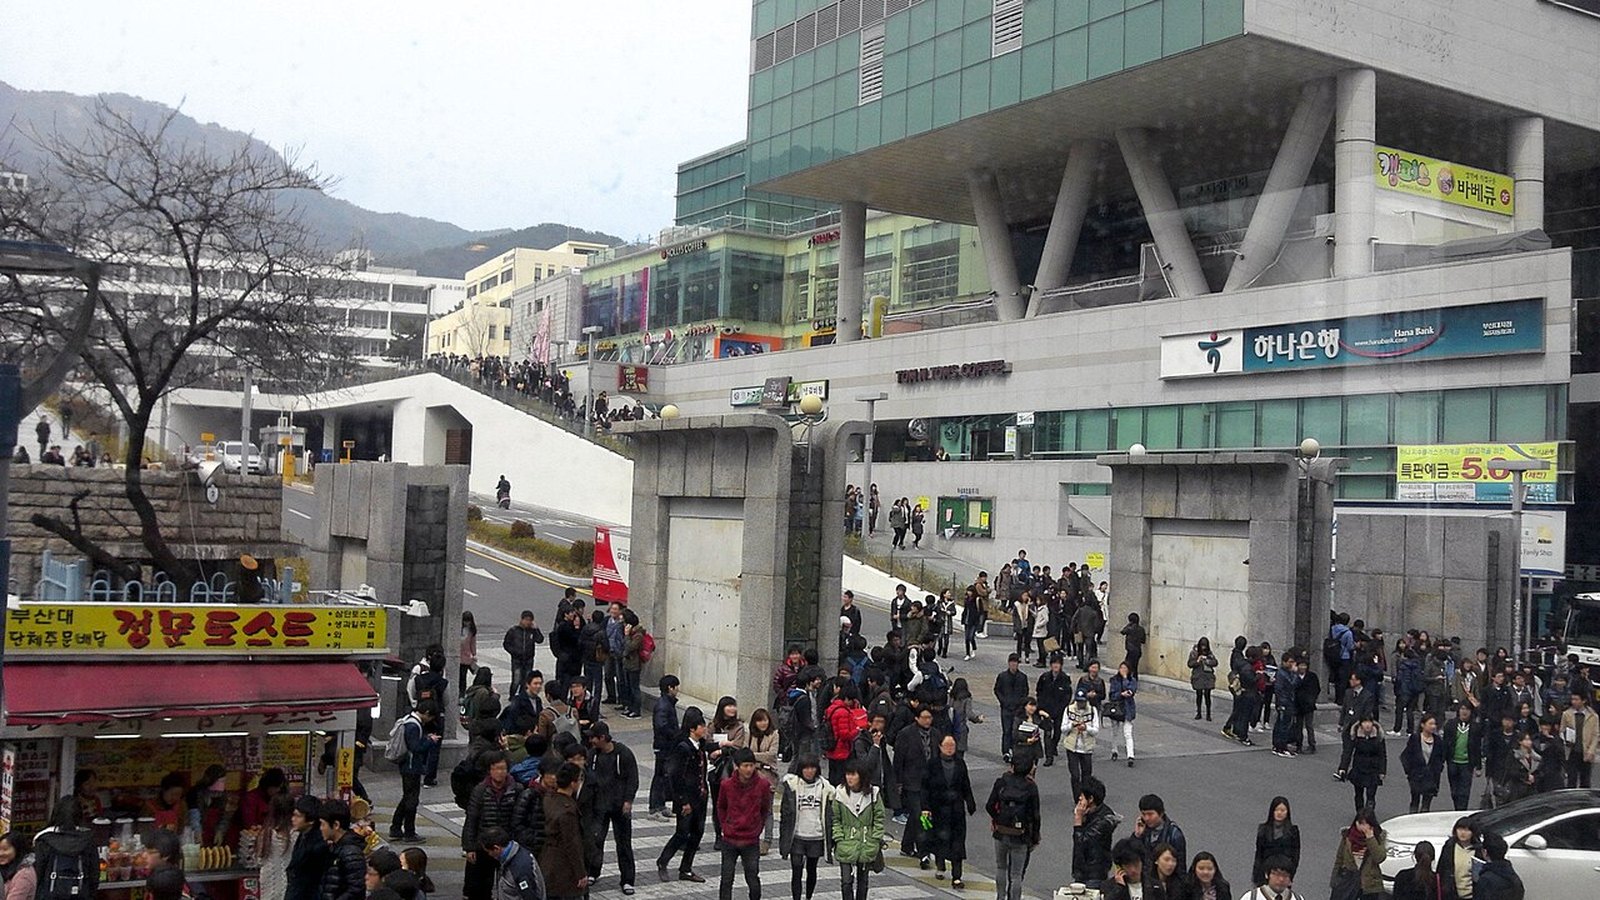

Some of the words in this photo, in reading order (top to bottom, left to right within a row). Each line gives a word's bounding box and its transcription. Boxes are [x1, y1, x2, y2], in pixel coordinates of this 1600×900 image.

[1457, 180, 1497, 206] 바베큐
[1394, 328, 1414, 338] Hana
[1415, 326, 1435, 336] Bank
[1254, 328, 1340, 362] 하나은행
[1354, 337, 1408, 347] www.hanabank.com
[896, 368, 918, 384] TOM
[961, 360, 1006, 379] COFFEE
[1401, 463, 1449, 479] 특판예금
[11, 609, 74, 625] 부산대
[113, 609, 317, 649] 정문토스트
[9, 630, 108, 648] 단체주문배달
